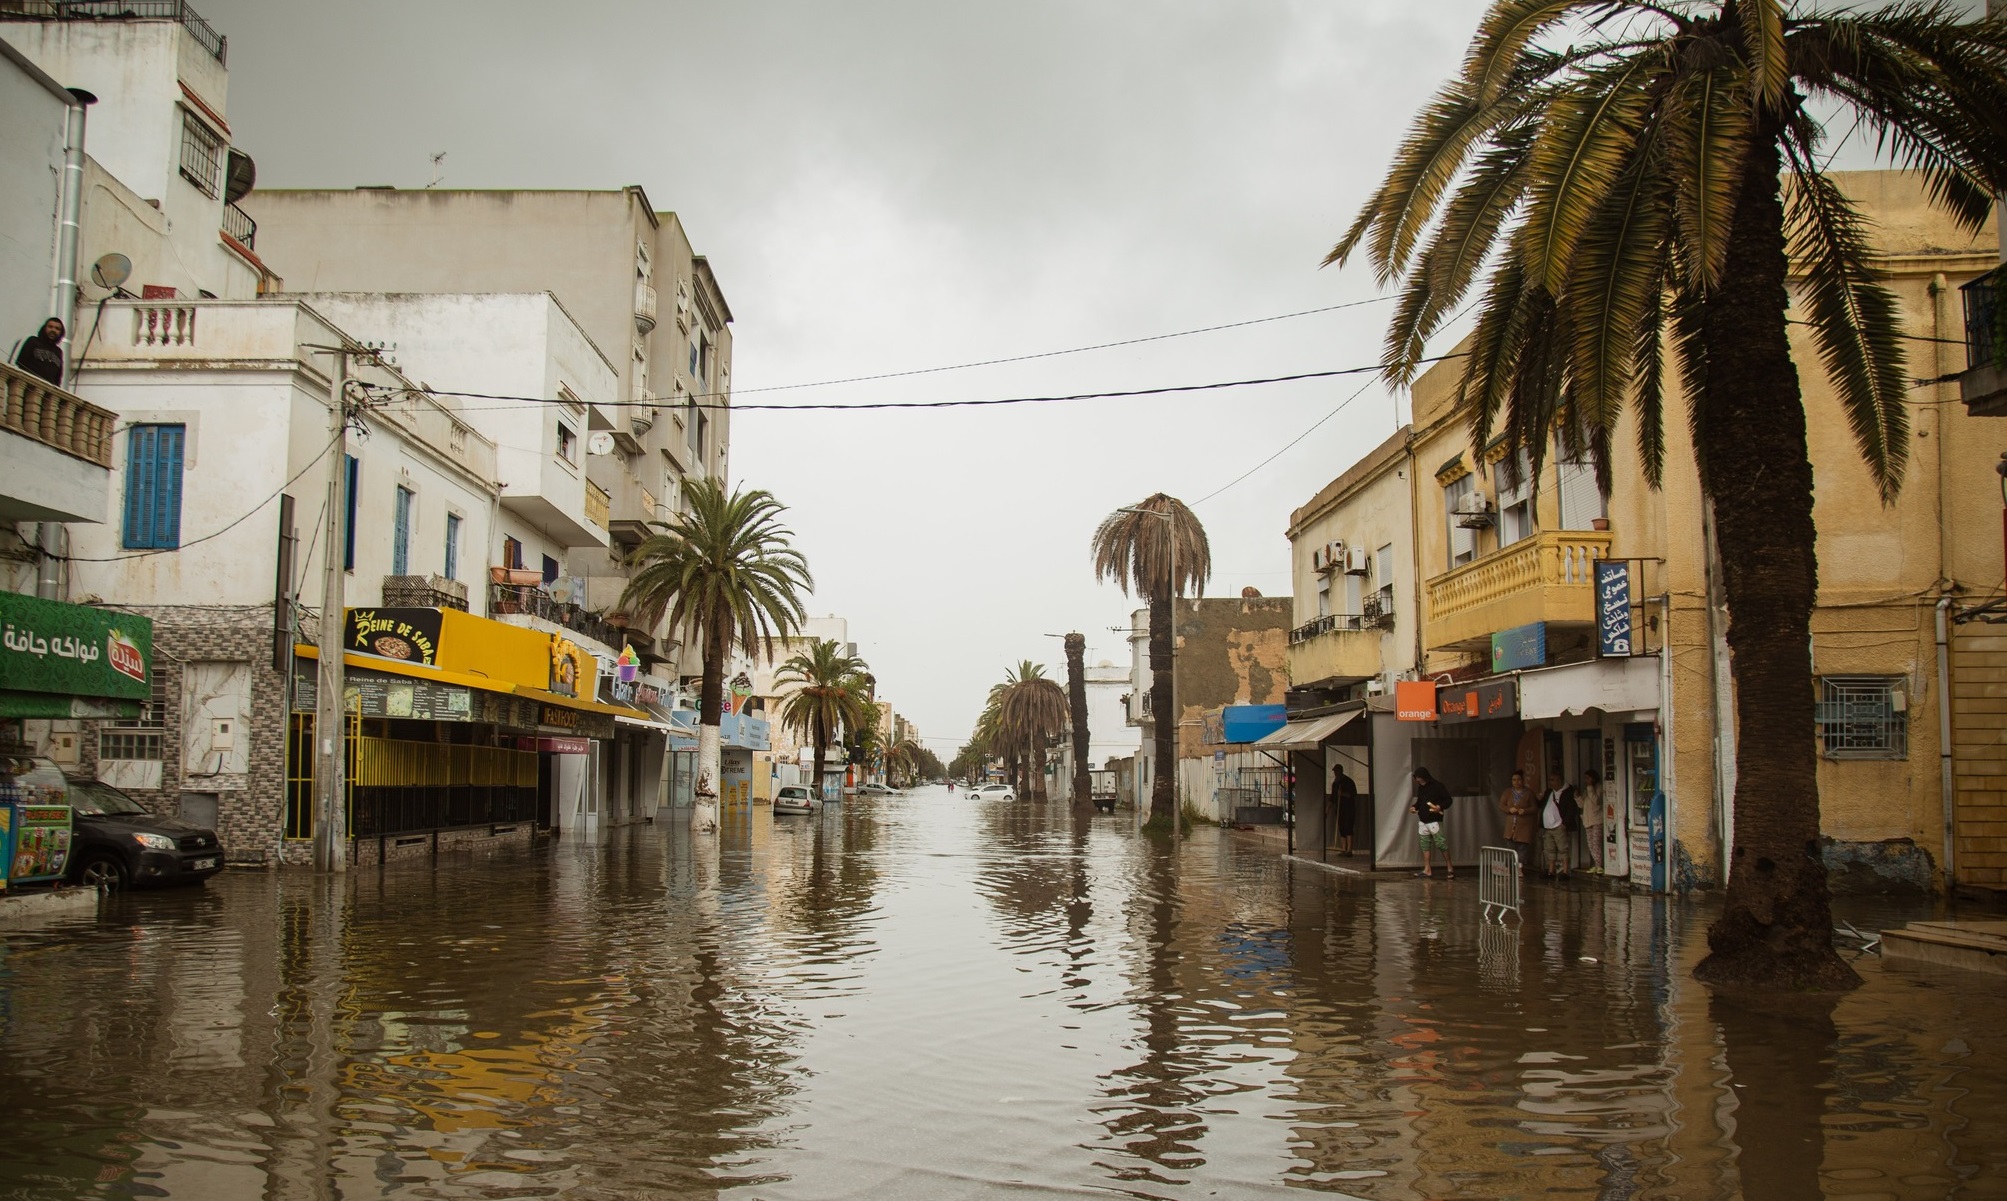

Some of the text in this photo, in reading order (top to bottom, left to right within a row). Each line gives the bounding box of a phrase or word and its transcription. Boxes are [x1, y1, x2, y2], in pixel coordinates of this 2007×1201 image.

[1601, 567, 1627, 585] هاتف
[1602, 580, 1627, 599] عمومي
[1603, 593, 1628, 615] نسخ
[4, 624, 100, 664] فواكه جافة
[355, 619, 435, 657] REINE DE SABA
[1603, 622, 1630, 645] فاكس
[1399, 710, 1431, 720] orange
